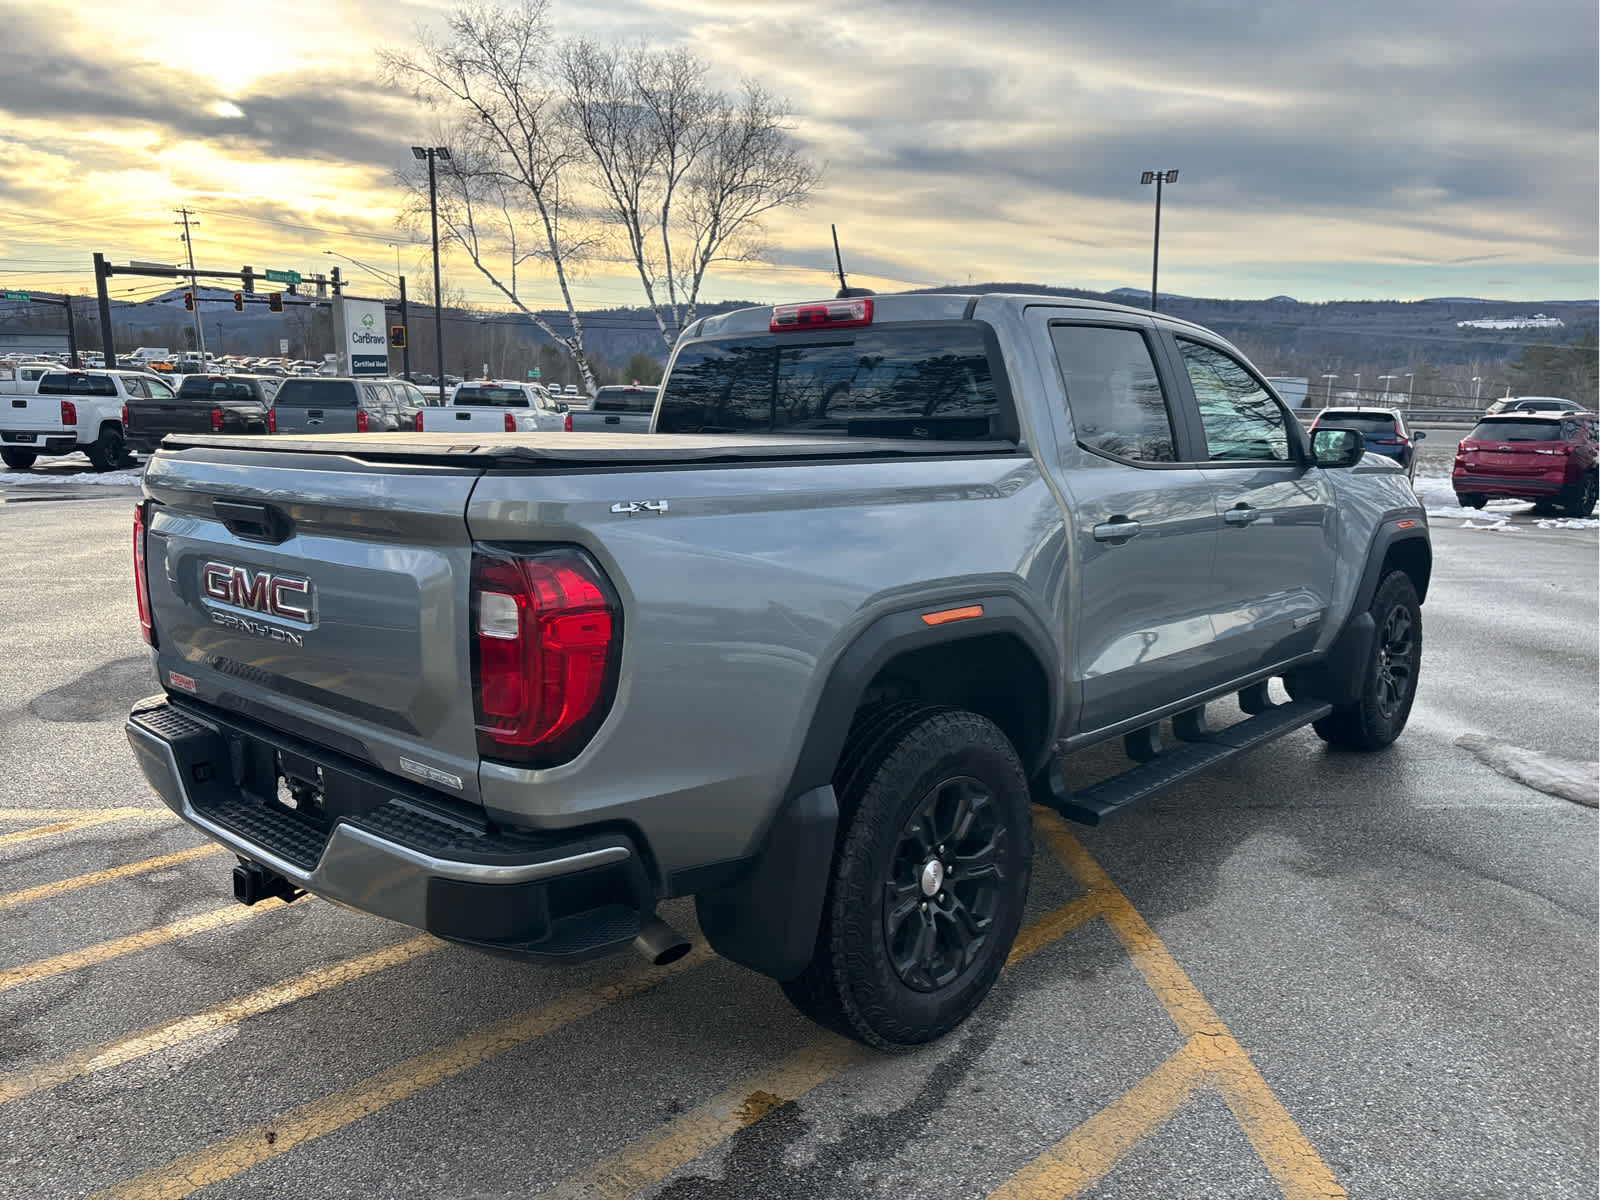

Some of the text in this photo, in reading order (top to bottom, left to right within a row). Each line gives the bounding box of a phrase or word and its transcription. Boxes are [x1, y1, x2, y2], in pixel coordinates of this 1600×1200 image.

[352, 332, 385, 344] CarBravo
[353, 360, 375, 368] Certified
[203, 562, 309, 623] GMC
[211, 611, 304, 648] CANYON
